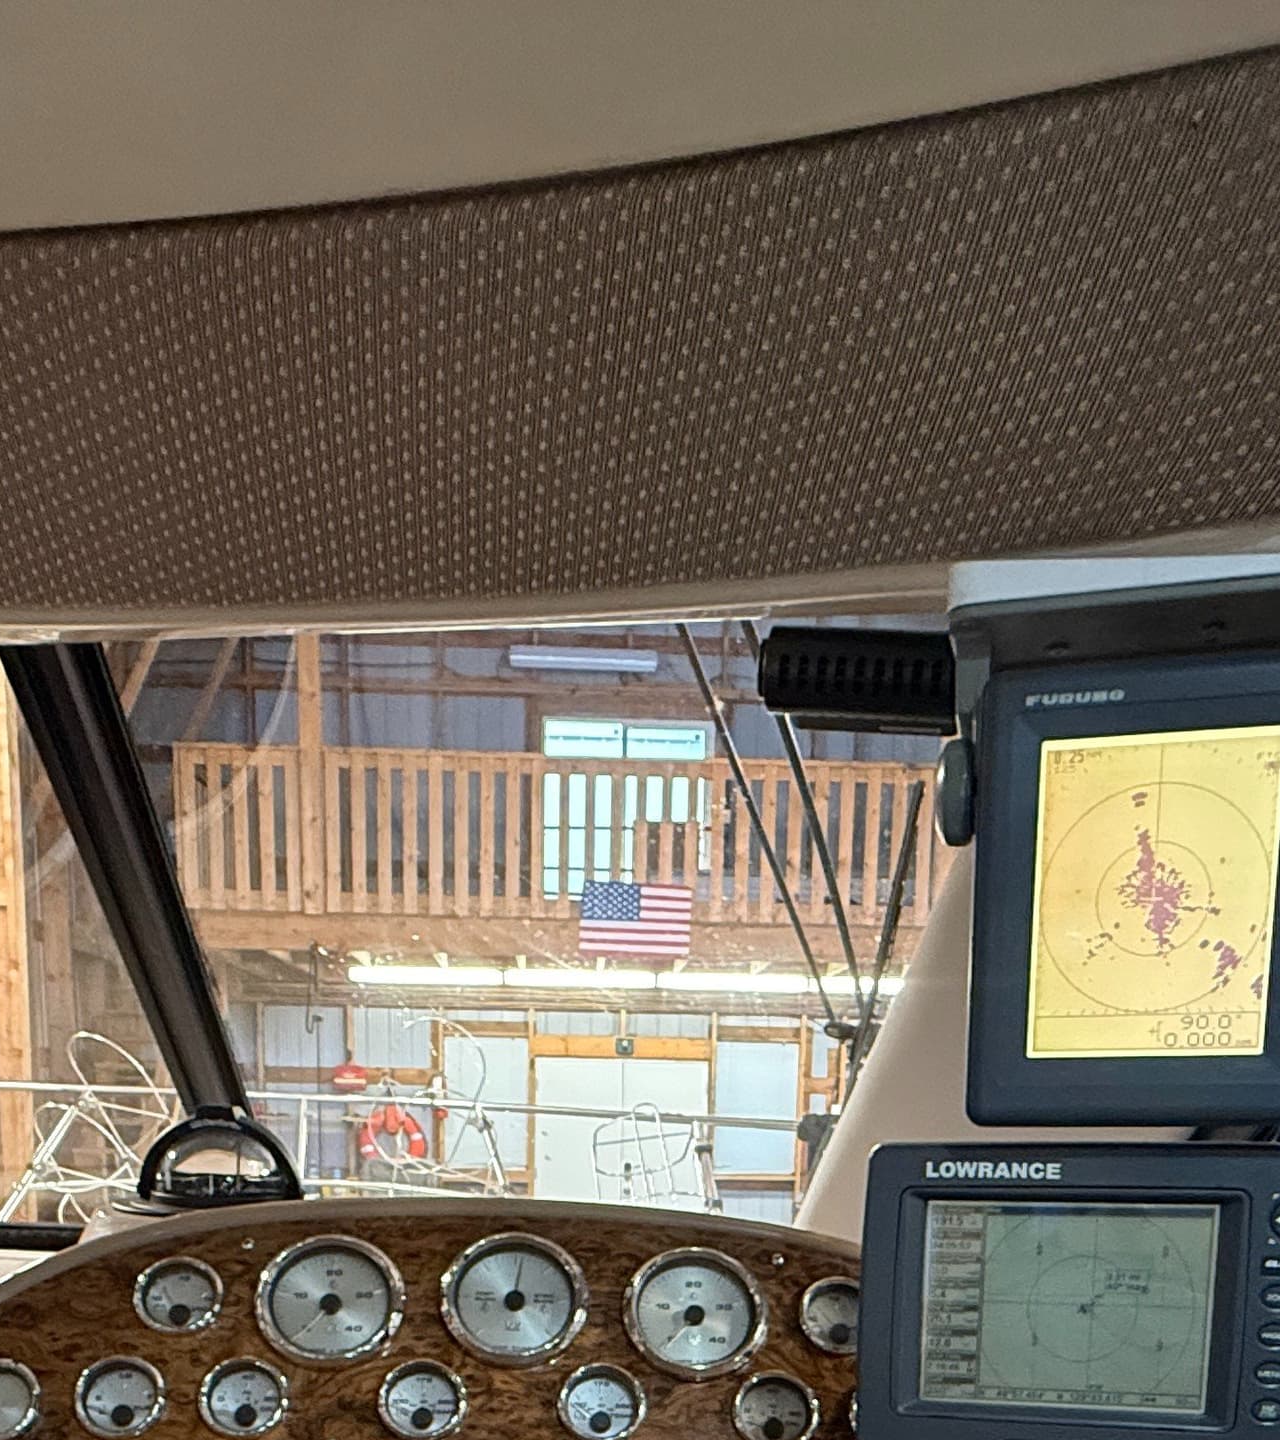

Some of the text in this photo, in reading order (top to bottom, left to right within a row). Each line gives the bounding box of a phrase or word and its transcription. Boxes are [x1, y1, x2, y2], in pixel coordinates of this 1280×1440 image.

[1024, 688, 1126, 707] FURUNO
[925, 1161, 1063, 1180] LOWRANCE
[708, 1336, 726, 1345] 40
